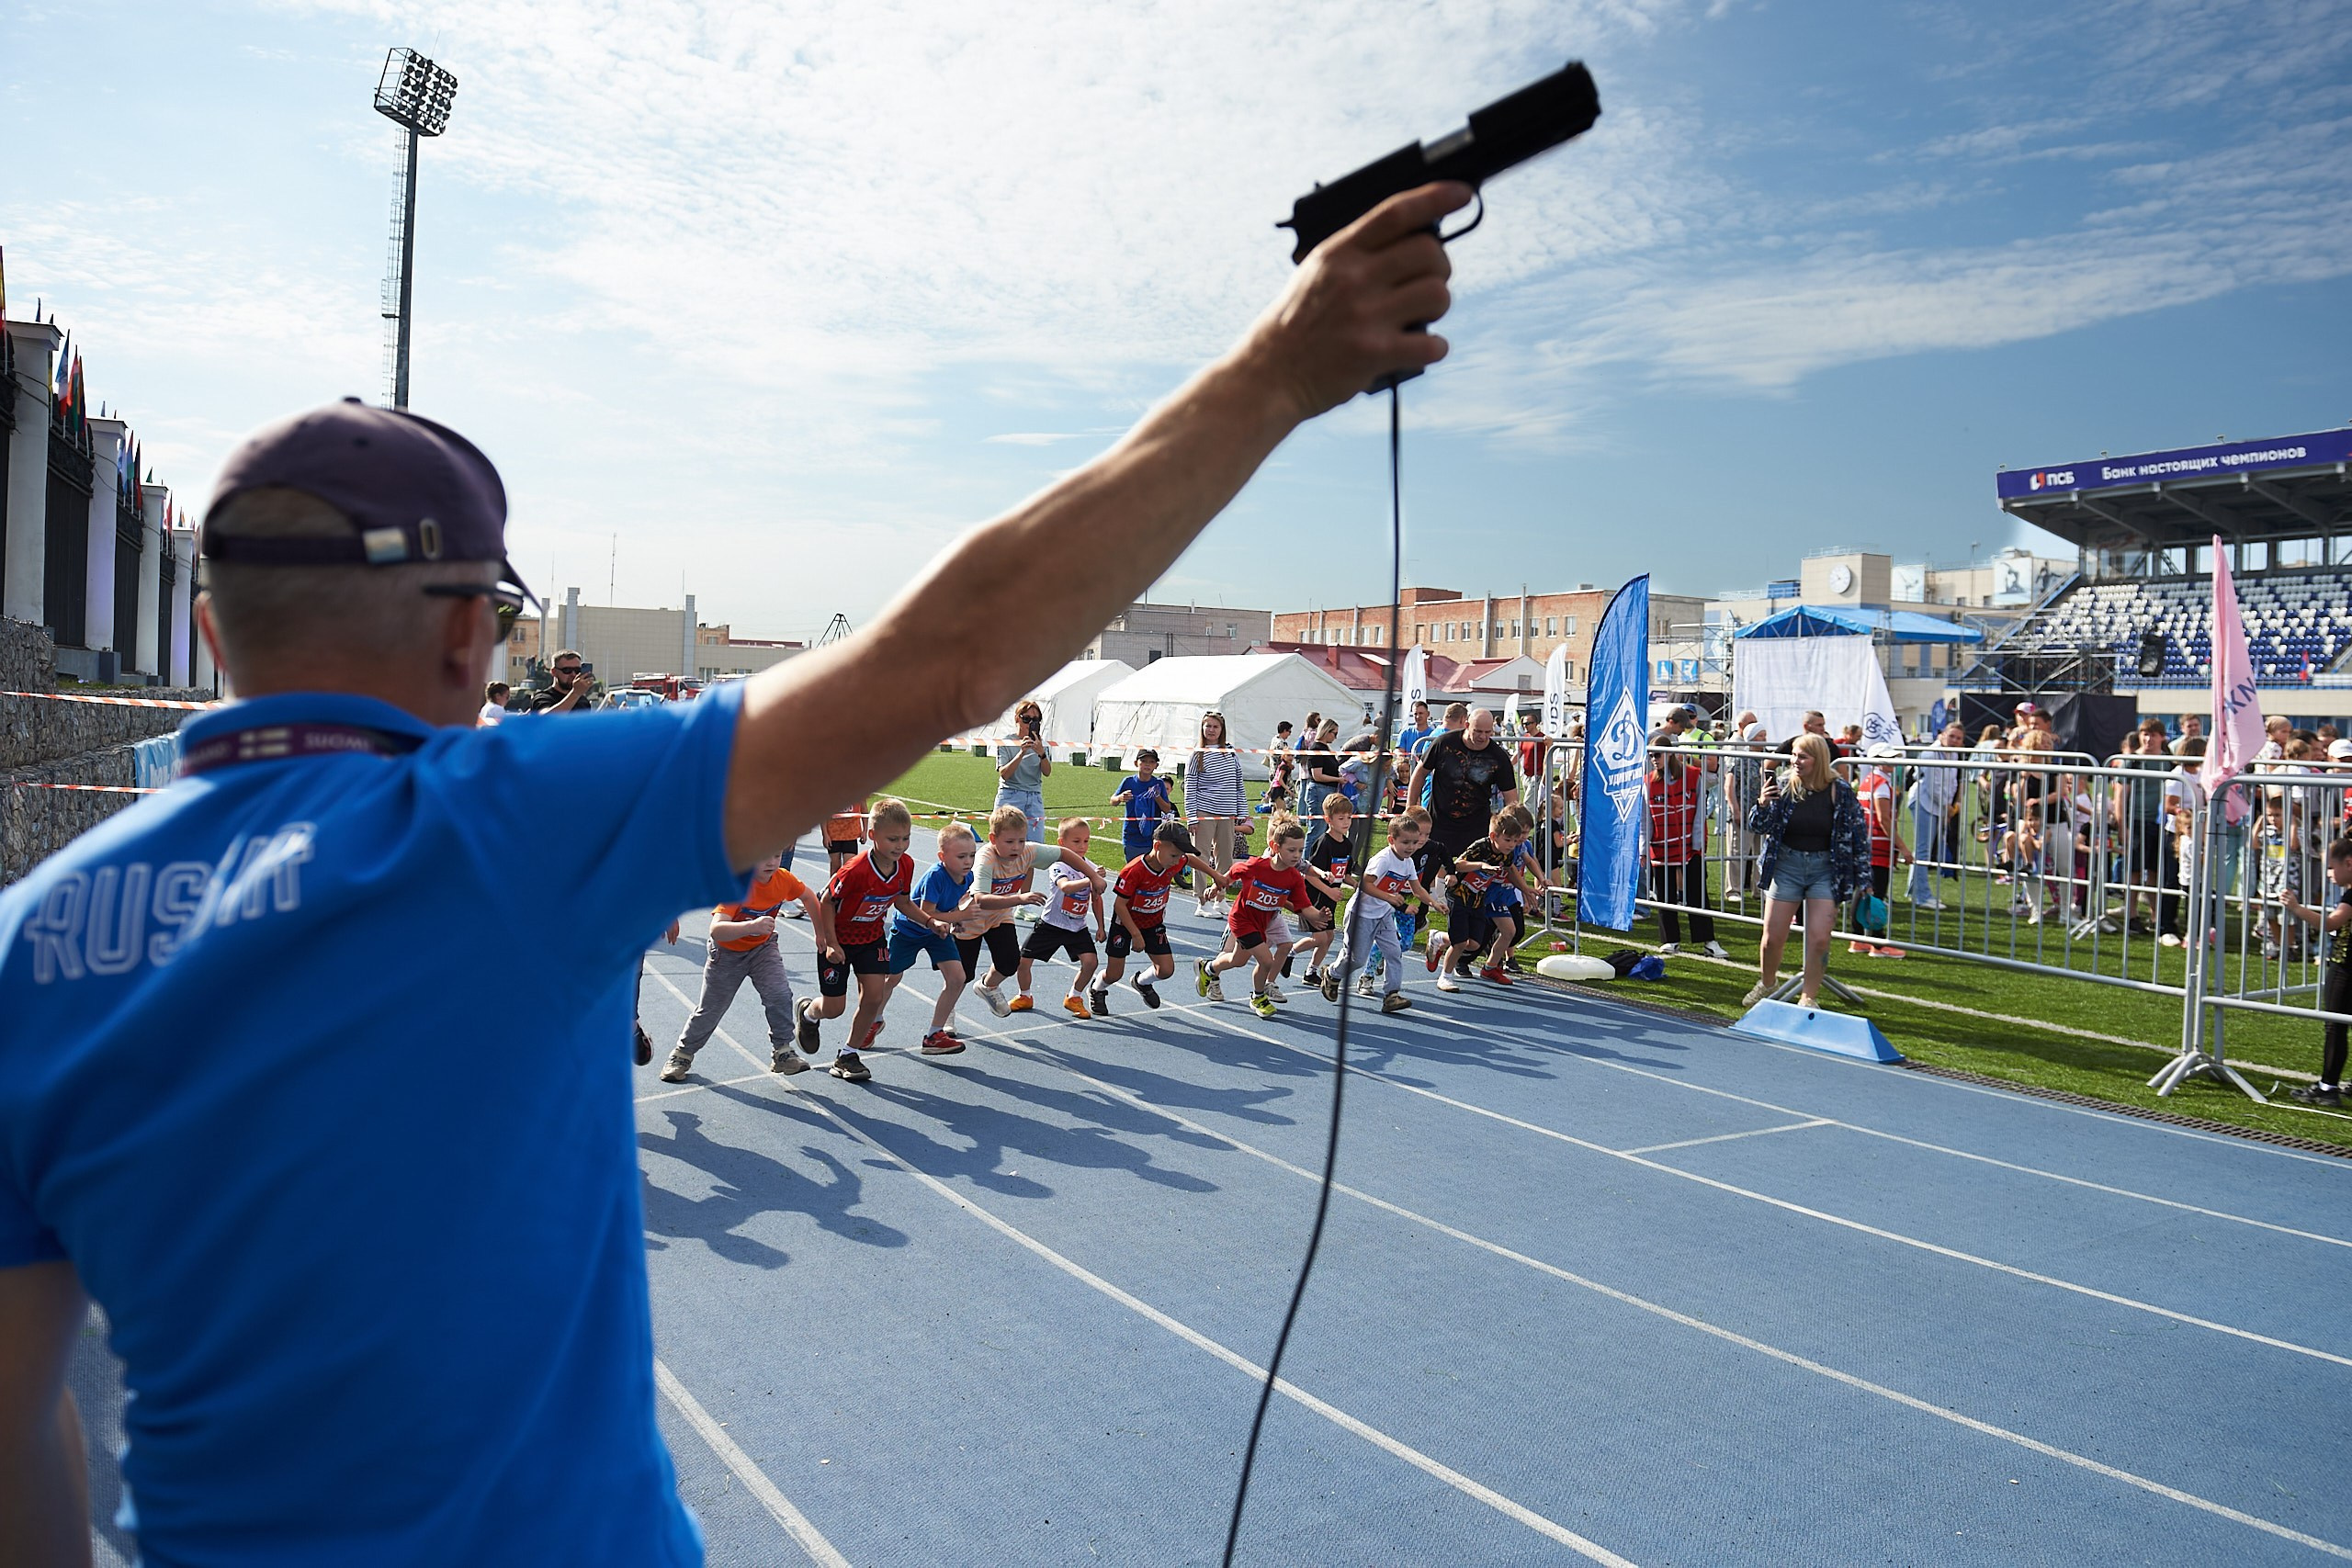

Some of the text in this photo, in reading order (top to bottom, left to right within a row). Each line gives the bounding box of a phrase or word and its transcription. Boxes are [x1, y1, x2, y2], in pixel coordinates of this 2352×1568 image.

[2101, 447, 2307, 479] Банк настоящих чемпионов
[2046, 471, 2075, 486] ПСБ
[1550, 693, 1558, 734] UDS
[992, 883, 1013, 895] 218
[1143, 897, 1163, 908] 245
[1256, 891, 1280, 906] 203
